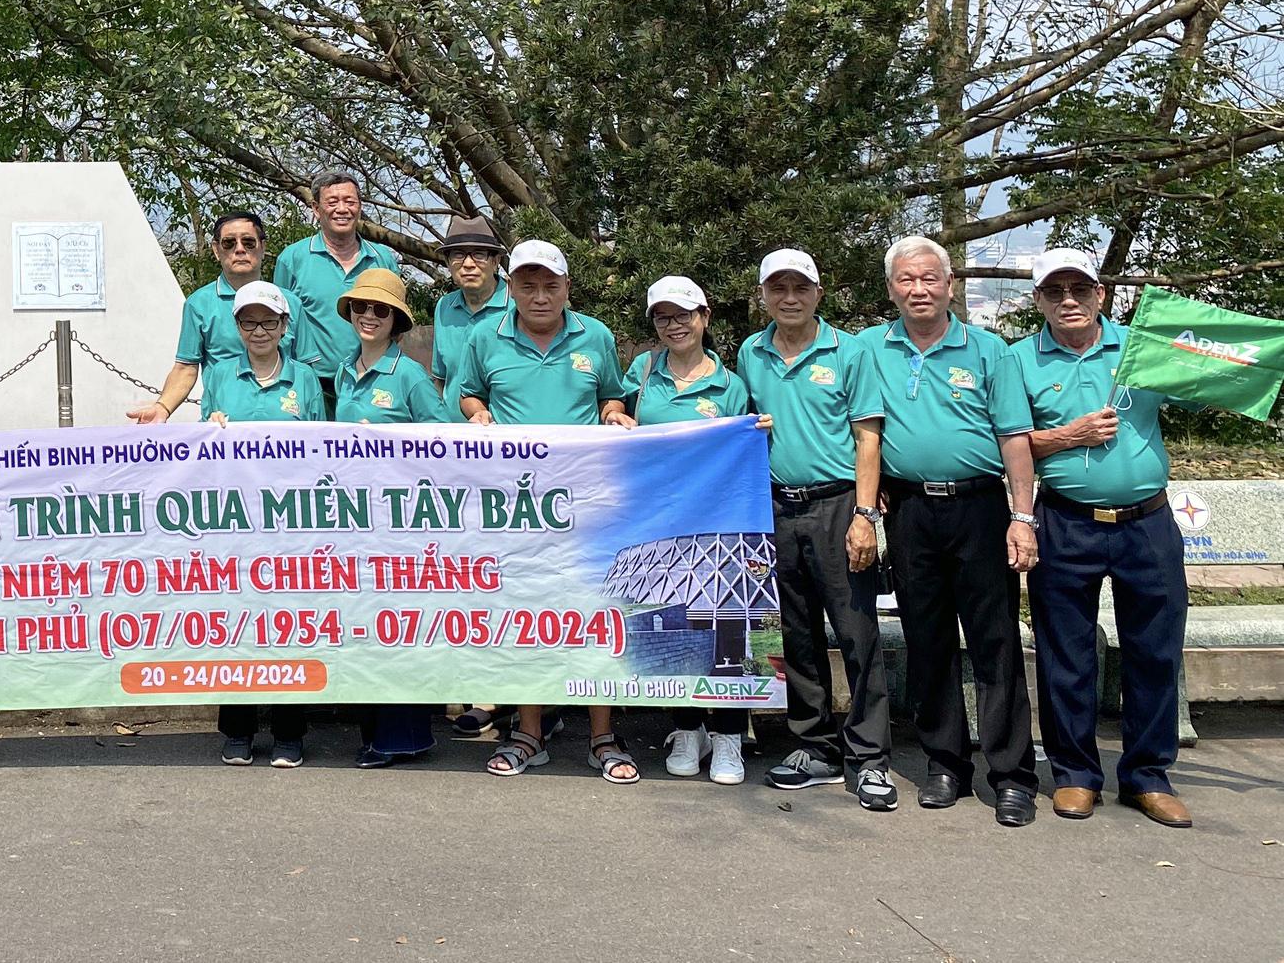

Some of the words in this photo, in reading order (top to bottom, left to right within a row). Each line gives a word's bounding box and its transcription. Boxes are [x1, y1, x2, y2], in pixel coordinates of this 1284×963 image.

[47, 445, 95, 466] BINH
[102, 438, 190, 464] PHƯỜNG
[196, 440, 226, 461] AN
[232, 434, 306, 459] KHÁNH
[323, 434, 395, 458] THÀNH
[8, 485, 144, 538] TRÌNH
[156, 488, 251, 537] QUA
[259, 474, 371, 530] MIỀN
[381, 478, 469, 530] TÂY
[479, 472, 573, 530] BẮC
[1183, 535, 1212, 547] EVN
[1, 554, 92, 605] NIỆM
[100, 558, 146, 596] 70
[155, 550, 241, 594] NĂM
[249, 543, 359, 591] CHIẾN
[366, 542, 502, 591] THẮNG
[16, 604, 89, 651] PHỦ
[375, 608, 626, 656] 07/05/2024)
[140, 666, 166, 686] 20
[182, 664, 307, 688] 24/04/2024
[565, 678, 597, 697] ĐƠN
[601, 679, 617, 701] VỊ
[620, 674, 640, 698] TỔ
[644, 678, 686, 698] CHỨC
[692, 677, 774, 695] ADENZ
